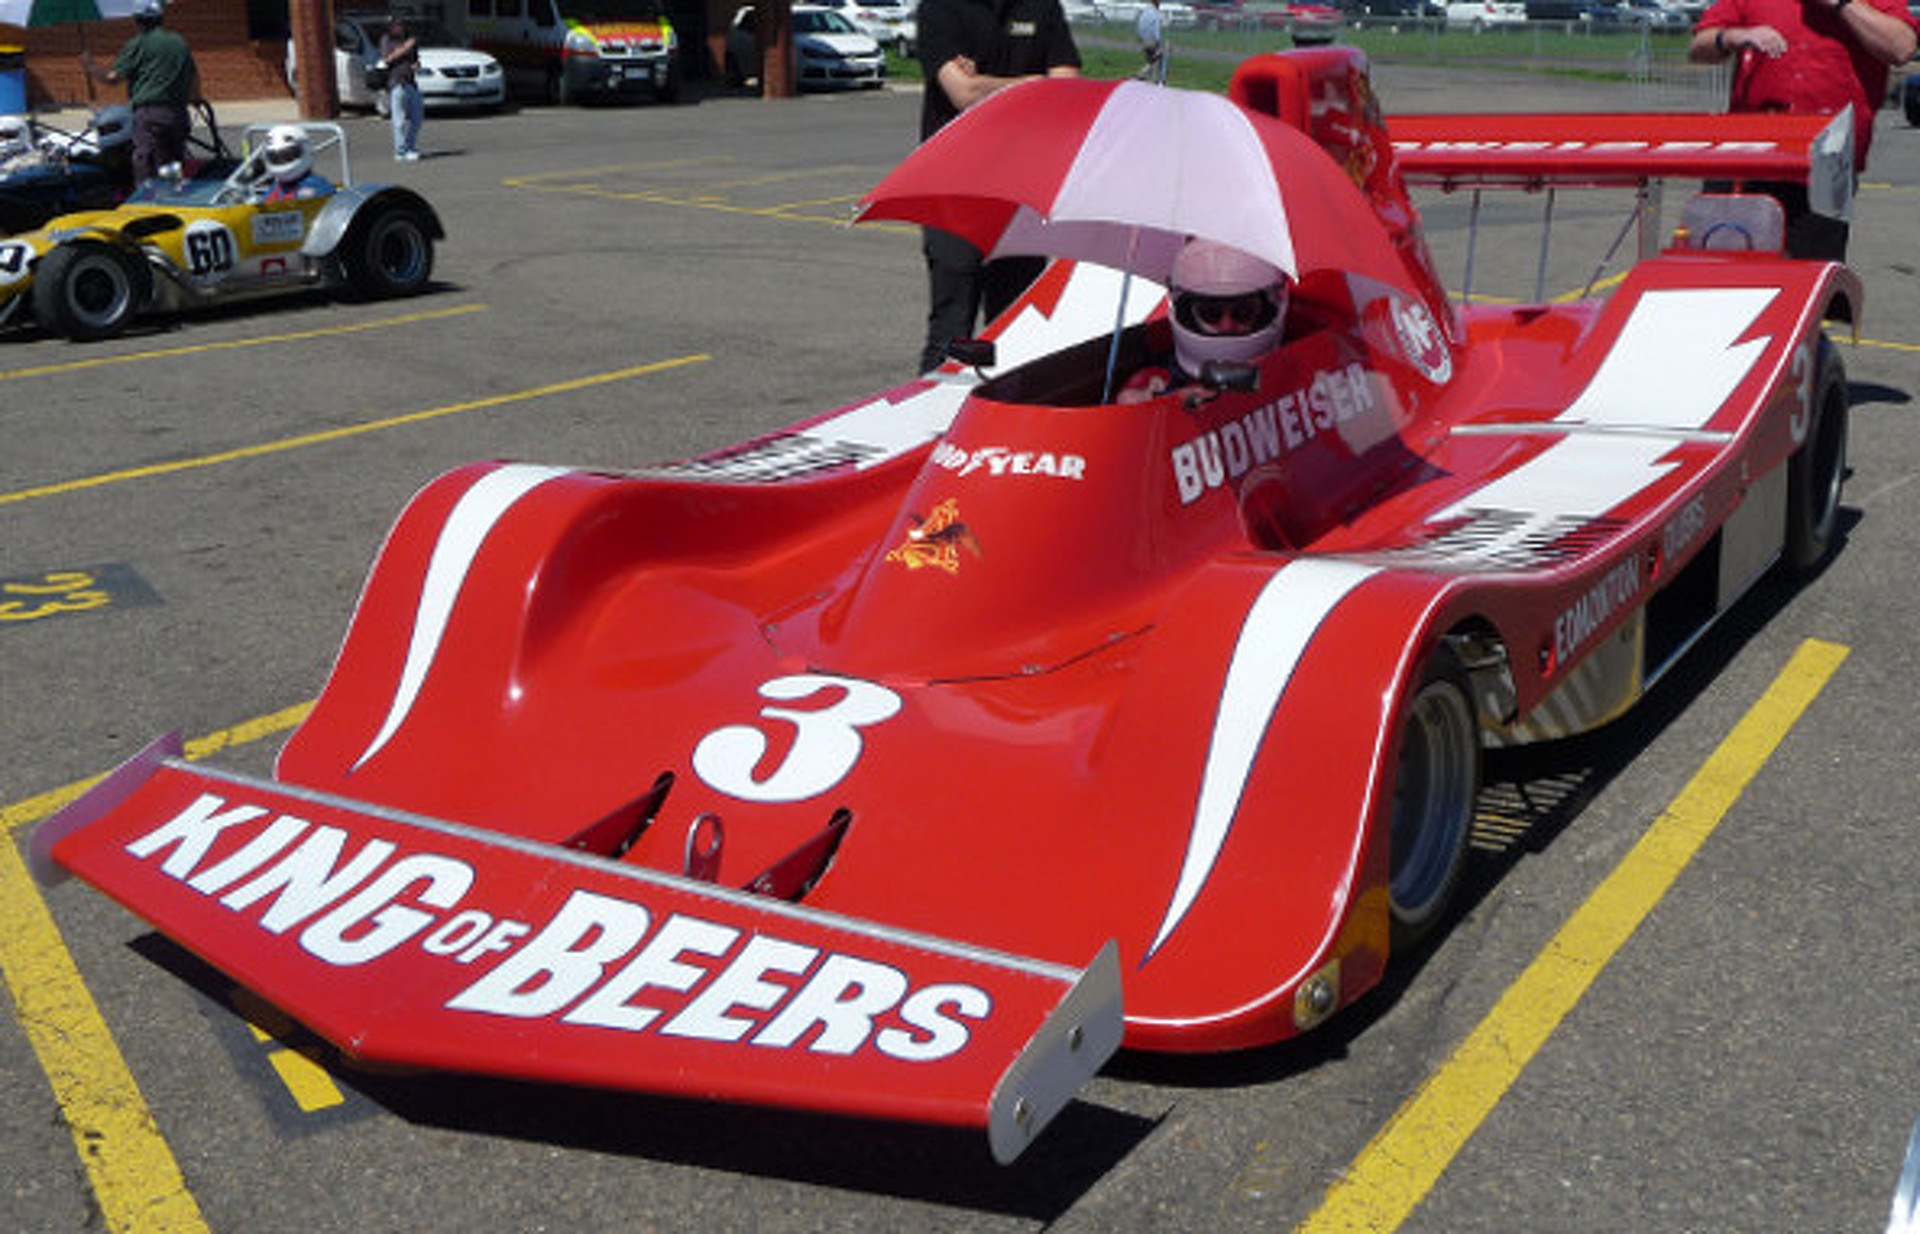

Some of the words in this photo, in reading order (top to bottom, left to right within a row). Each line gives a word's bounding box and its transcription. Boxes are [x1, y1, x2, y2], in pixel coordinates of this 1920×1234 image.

[187, 227, 233, 275] 60
[1172, 362, 1374, 505] BUDWEISER
[1790, 342, 1811, 442] 3
[1555, 552, 1640, 664] EDMONTON
[691, 674, 903, 803] 3
[124, 791, 476, 967] KING
[420, 909, 533, 964] OF
[443, 888, 993, 1062] BEERS
